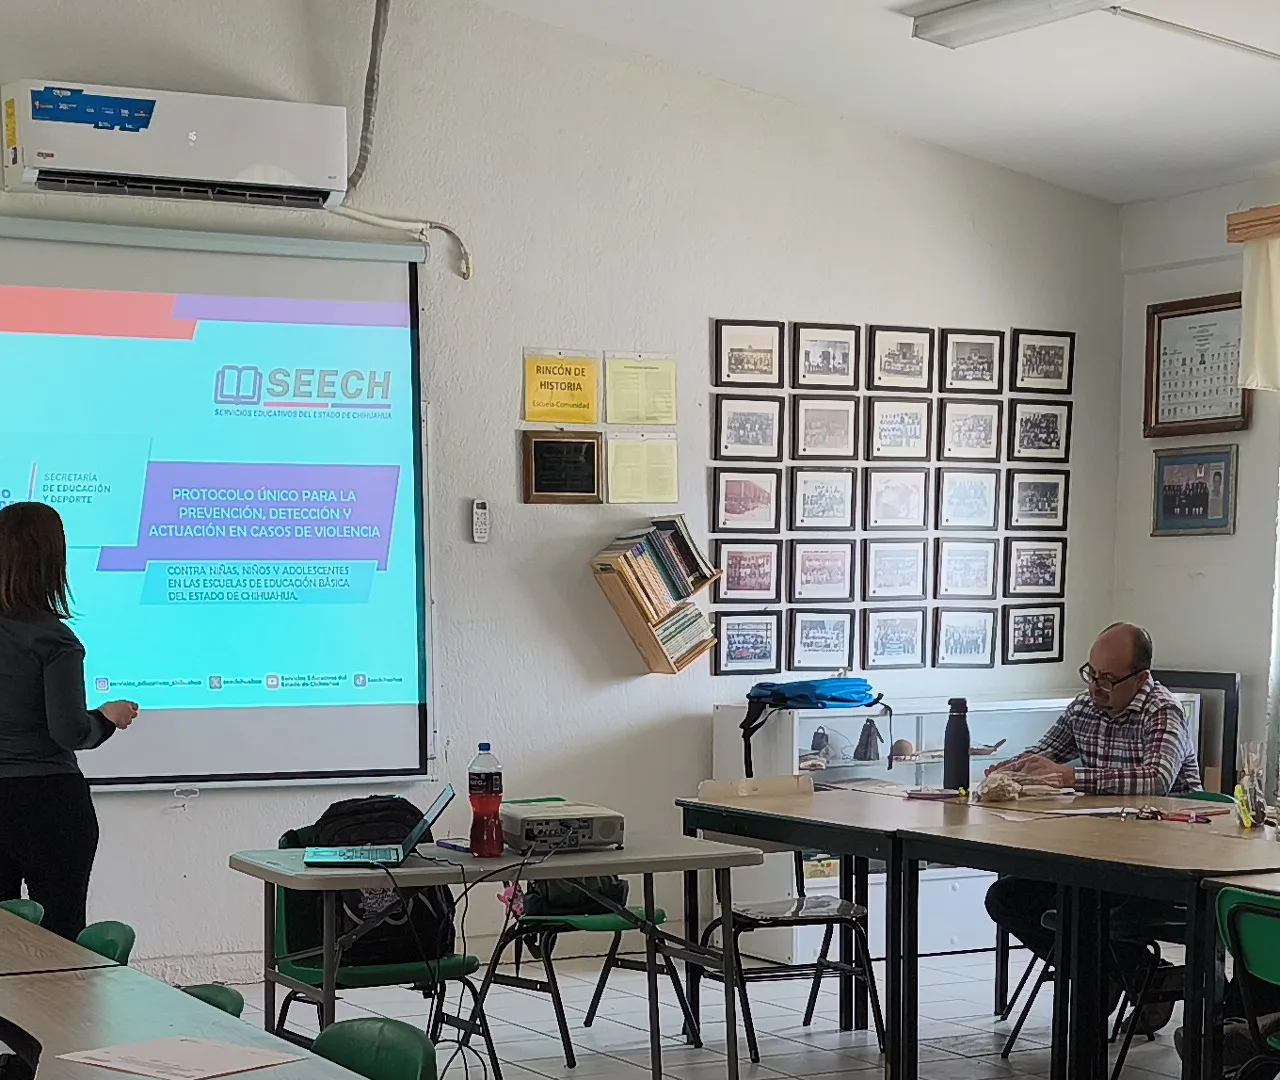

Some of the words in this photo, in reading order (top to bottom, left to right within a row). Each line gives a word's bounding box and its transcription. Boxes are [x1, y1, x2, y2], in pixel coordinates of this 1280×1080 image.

[535, 363, 572, 376] RINCÓN
[573, 367, 586, 377] DE
[266, 367, 392, 400] SEECH
[539, 380, 583, 392] HISTORIA
[532, 399, 555, 408] Escuela
[555, 400, 590, 410] Comunidad
[214, 408, 252, 417] SERVICIOS
[253, 409, 298, 418] EDUCATIVOS
[298, 410, 312, 418] DEL
[313, 410, 341, 419] ESTADO
[341, 411, 351, 419] DE
[352, 411, 392, 420] CHIHUAHUA
[43, 471, 98, 482] SECRETARÍA
[42, 484, 56, 493] DE
[56, 483, 111, 494] EDUCACIÓN
[172, 488, 255, 501] PROTOCOLO
[257, 486, 299, 502] ÚNICO
[301, 489, 337, 502] PARA
[340, 489, 357, 502] LA
[42, 494, 50, 503] Y
[50, 495, 93, 504] DEPORTE
[179, 504, 266, 520] PREVENCIÓN,
[269, 505, 340, 520] DETECCIÓN
[342, 507, 352, 520] Y
[148, 522, 226, 538] ACTUACIÓN
[229, 525, 247, 537] EN
[249, 525, 291, 538] CASOS
[294, 525, 312, 538] DE
[314, 525, 381, 538] VIOLENCIA
[167, 566, 207, 576] CONTRA
[209, 563, 240, 576] NIÑAS,
[242, 563, 271, 576] NIÑOS
[272, 565, 280, 576] Y
[281, 565, 349, 575] ADOLESCENTES
[167, 579, 182, 588] EN
[183, 579, 201, 588] LAS
[202, 579, 247, 588] ESCUELAS
[248, 578, 262, 588] DE
[264, 576, 317, 588] EDUCACIÓN
[318, 576, 350, 588] BÁSICA
[168, 591, 187, 601] DEL
[188, 591, 225, 601] ESTADO
[226, 591, 240, 601] DE
[240, 591, 298, 601] CHIHUAHUA.
